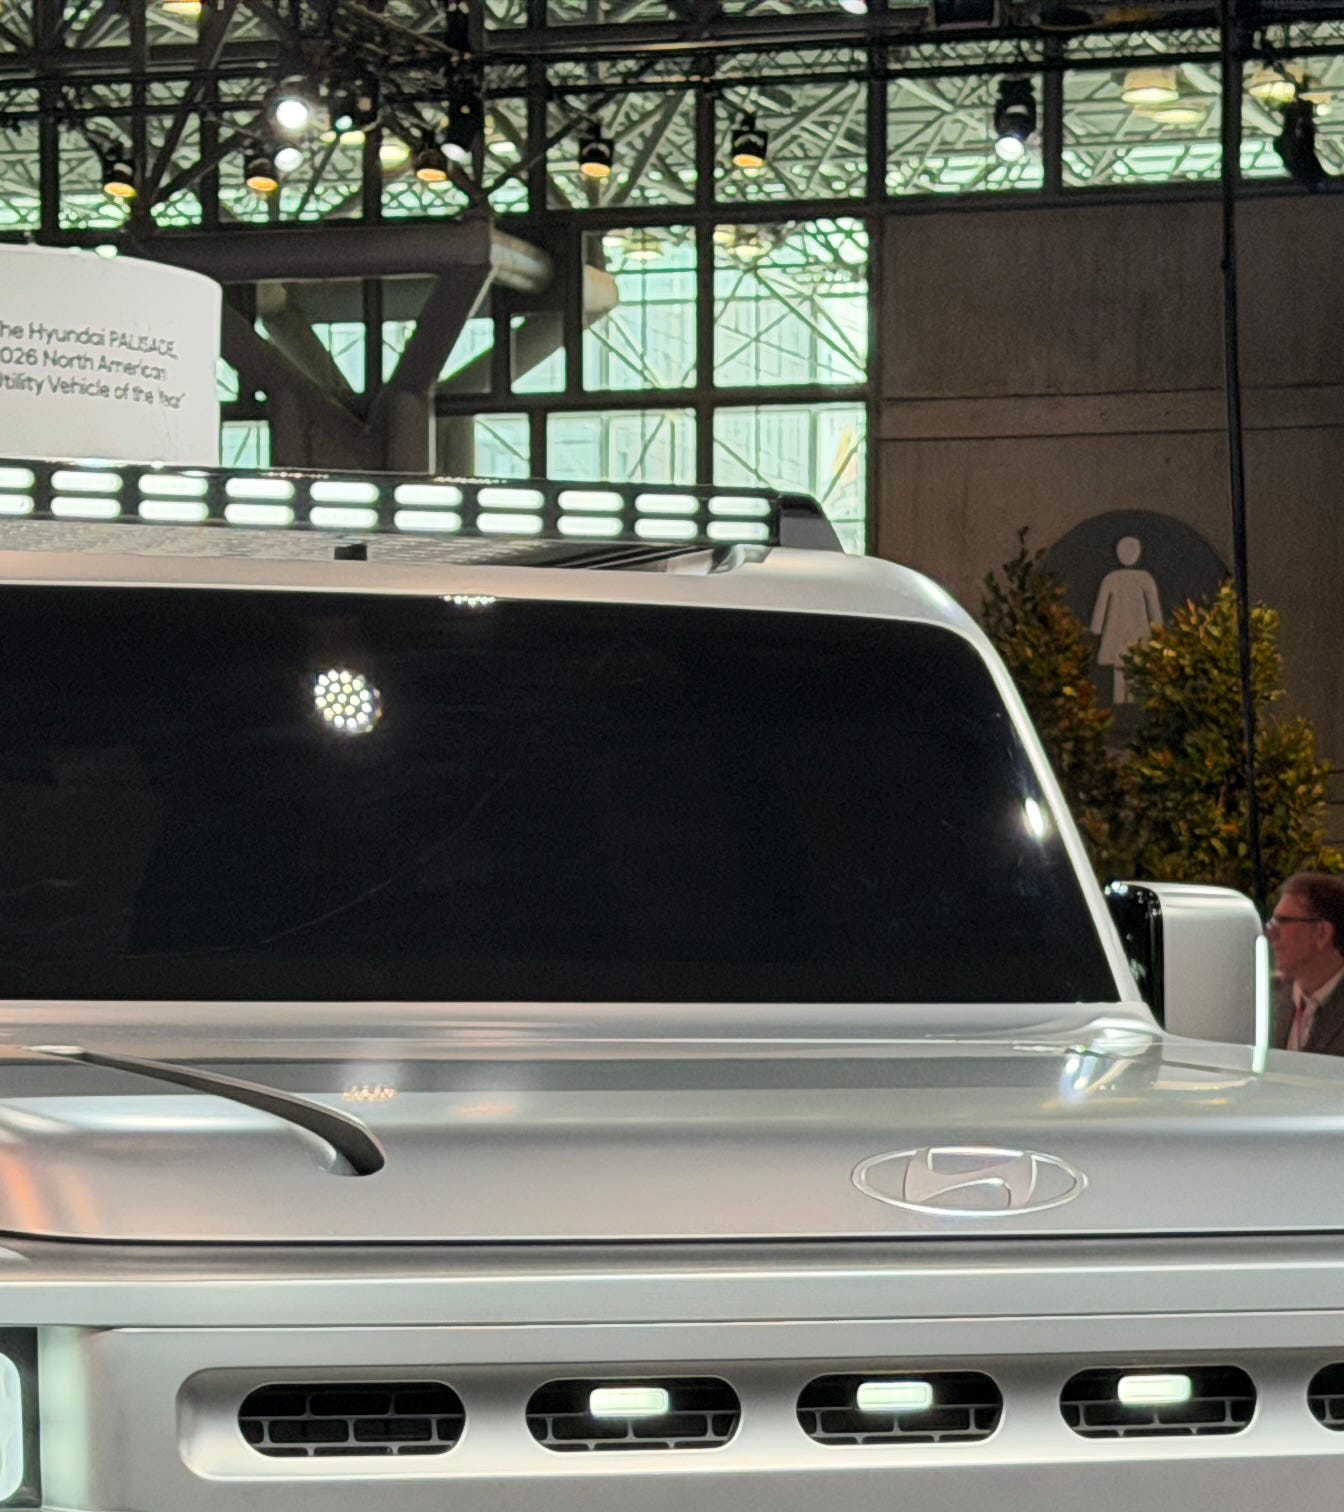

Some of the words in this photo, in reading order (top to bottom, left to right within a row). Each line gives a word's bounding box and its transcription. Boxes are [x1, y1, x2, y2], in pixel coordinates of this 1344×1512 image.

[29, 322, 105, 346] Hyundai
[43, 349, 94, 371] North
[47, 375, 110, 398] Vehicle
[114, 382, 130, 400] of
